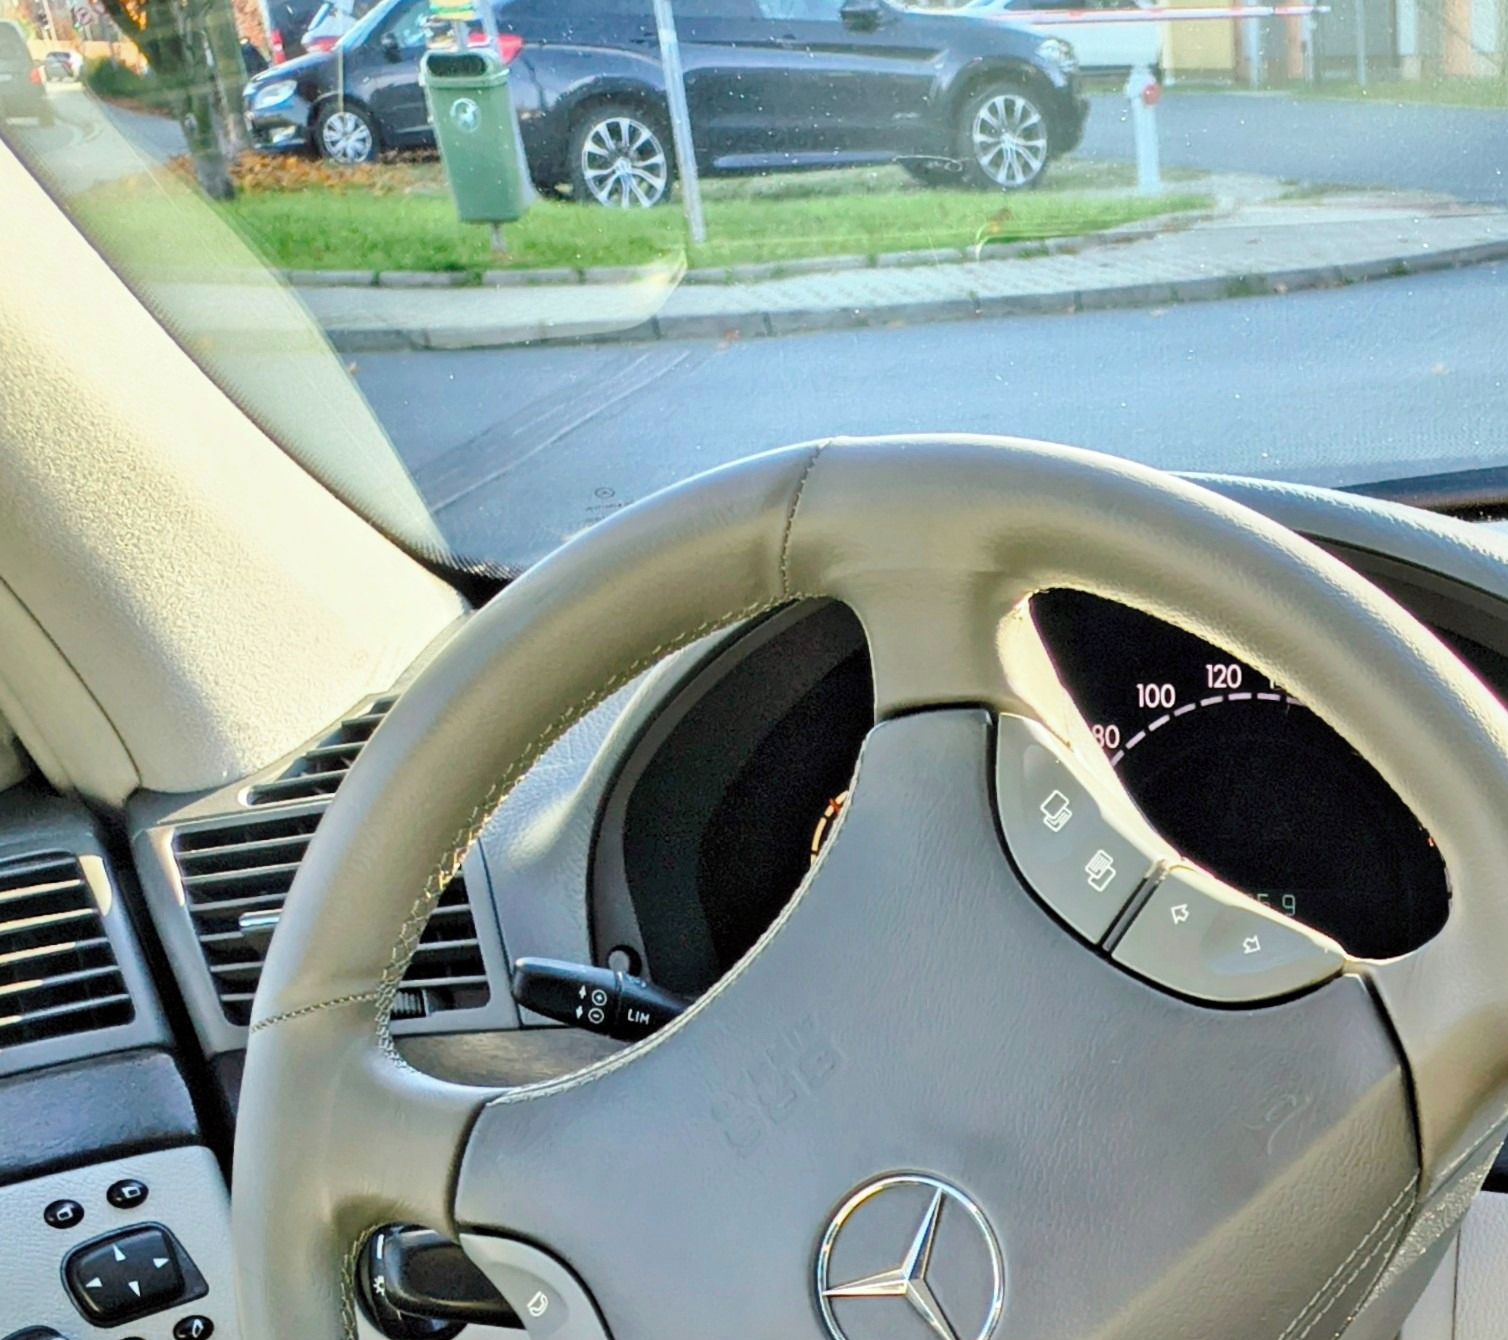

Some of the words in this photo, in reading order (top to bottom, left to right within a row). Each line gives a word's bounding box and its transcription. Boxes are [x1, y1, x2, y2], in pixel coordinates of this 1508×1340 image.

[1206, 664, 1242, 689] 120
[1137, 683, 1176, 709] 100
[628, 1008, 650, 1025] LIM
